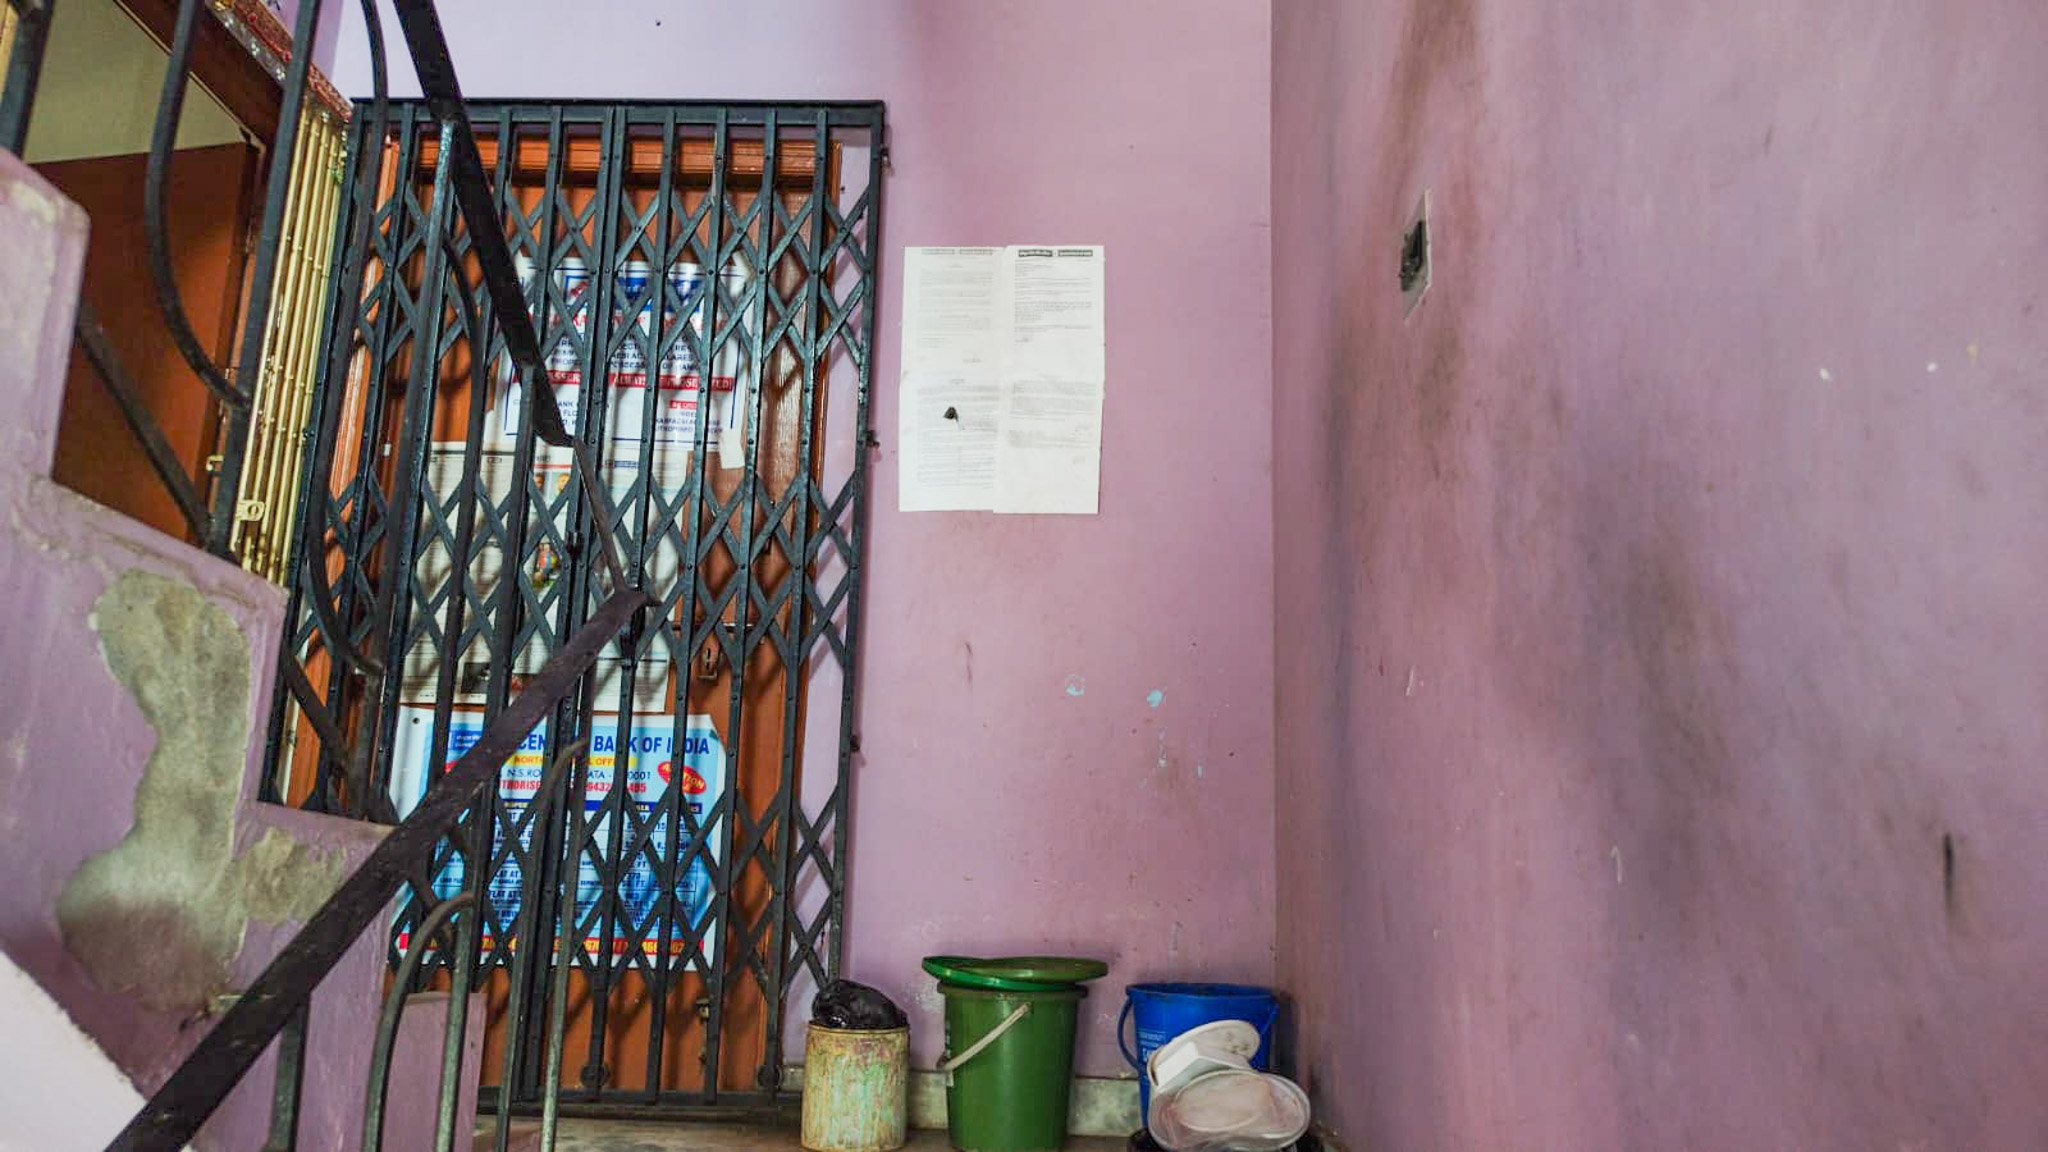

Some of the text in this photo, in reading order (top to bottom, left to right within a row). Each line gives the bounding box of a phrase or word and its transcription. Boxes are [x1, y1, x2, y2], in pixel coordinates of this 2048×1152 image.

[594, 736, 710, 754] BAK OF IDIA
